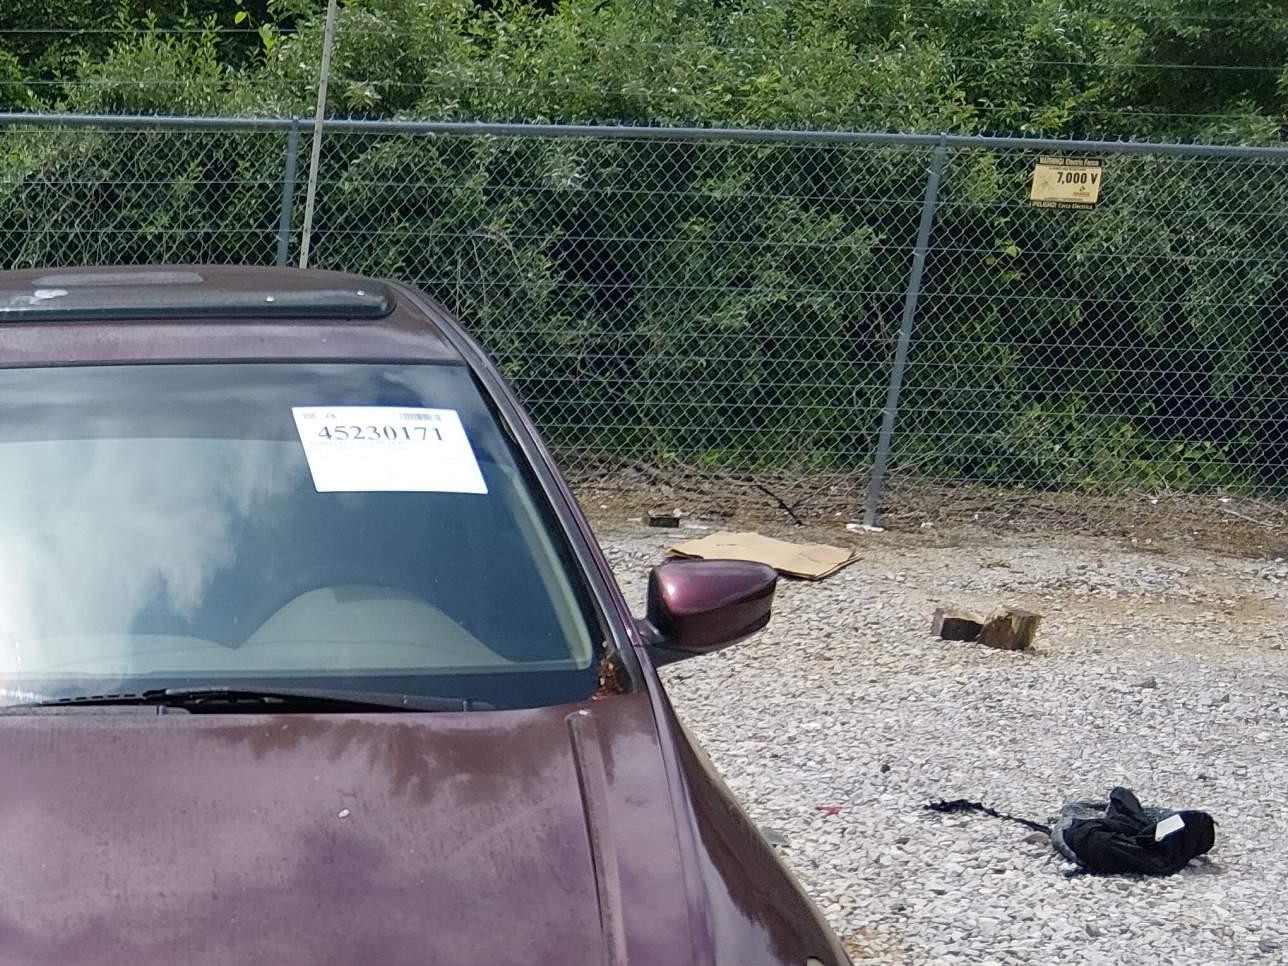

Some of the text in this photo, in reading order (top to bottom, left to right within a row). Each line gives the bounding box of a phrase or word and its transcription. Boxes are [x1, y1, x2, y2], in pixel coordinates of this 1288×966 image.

[1057, 172, 1098, 184] 7,000 V
[318, 425, 444, 441] 45230171
